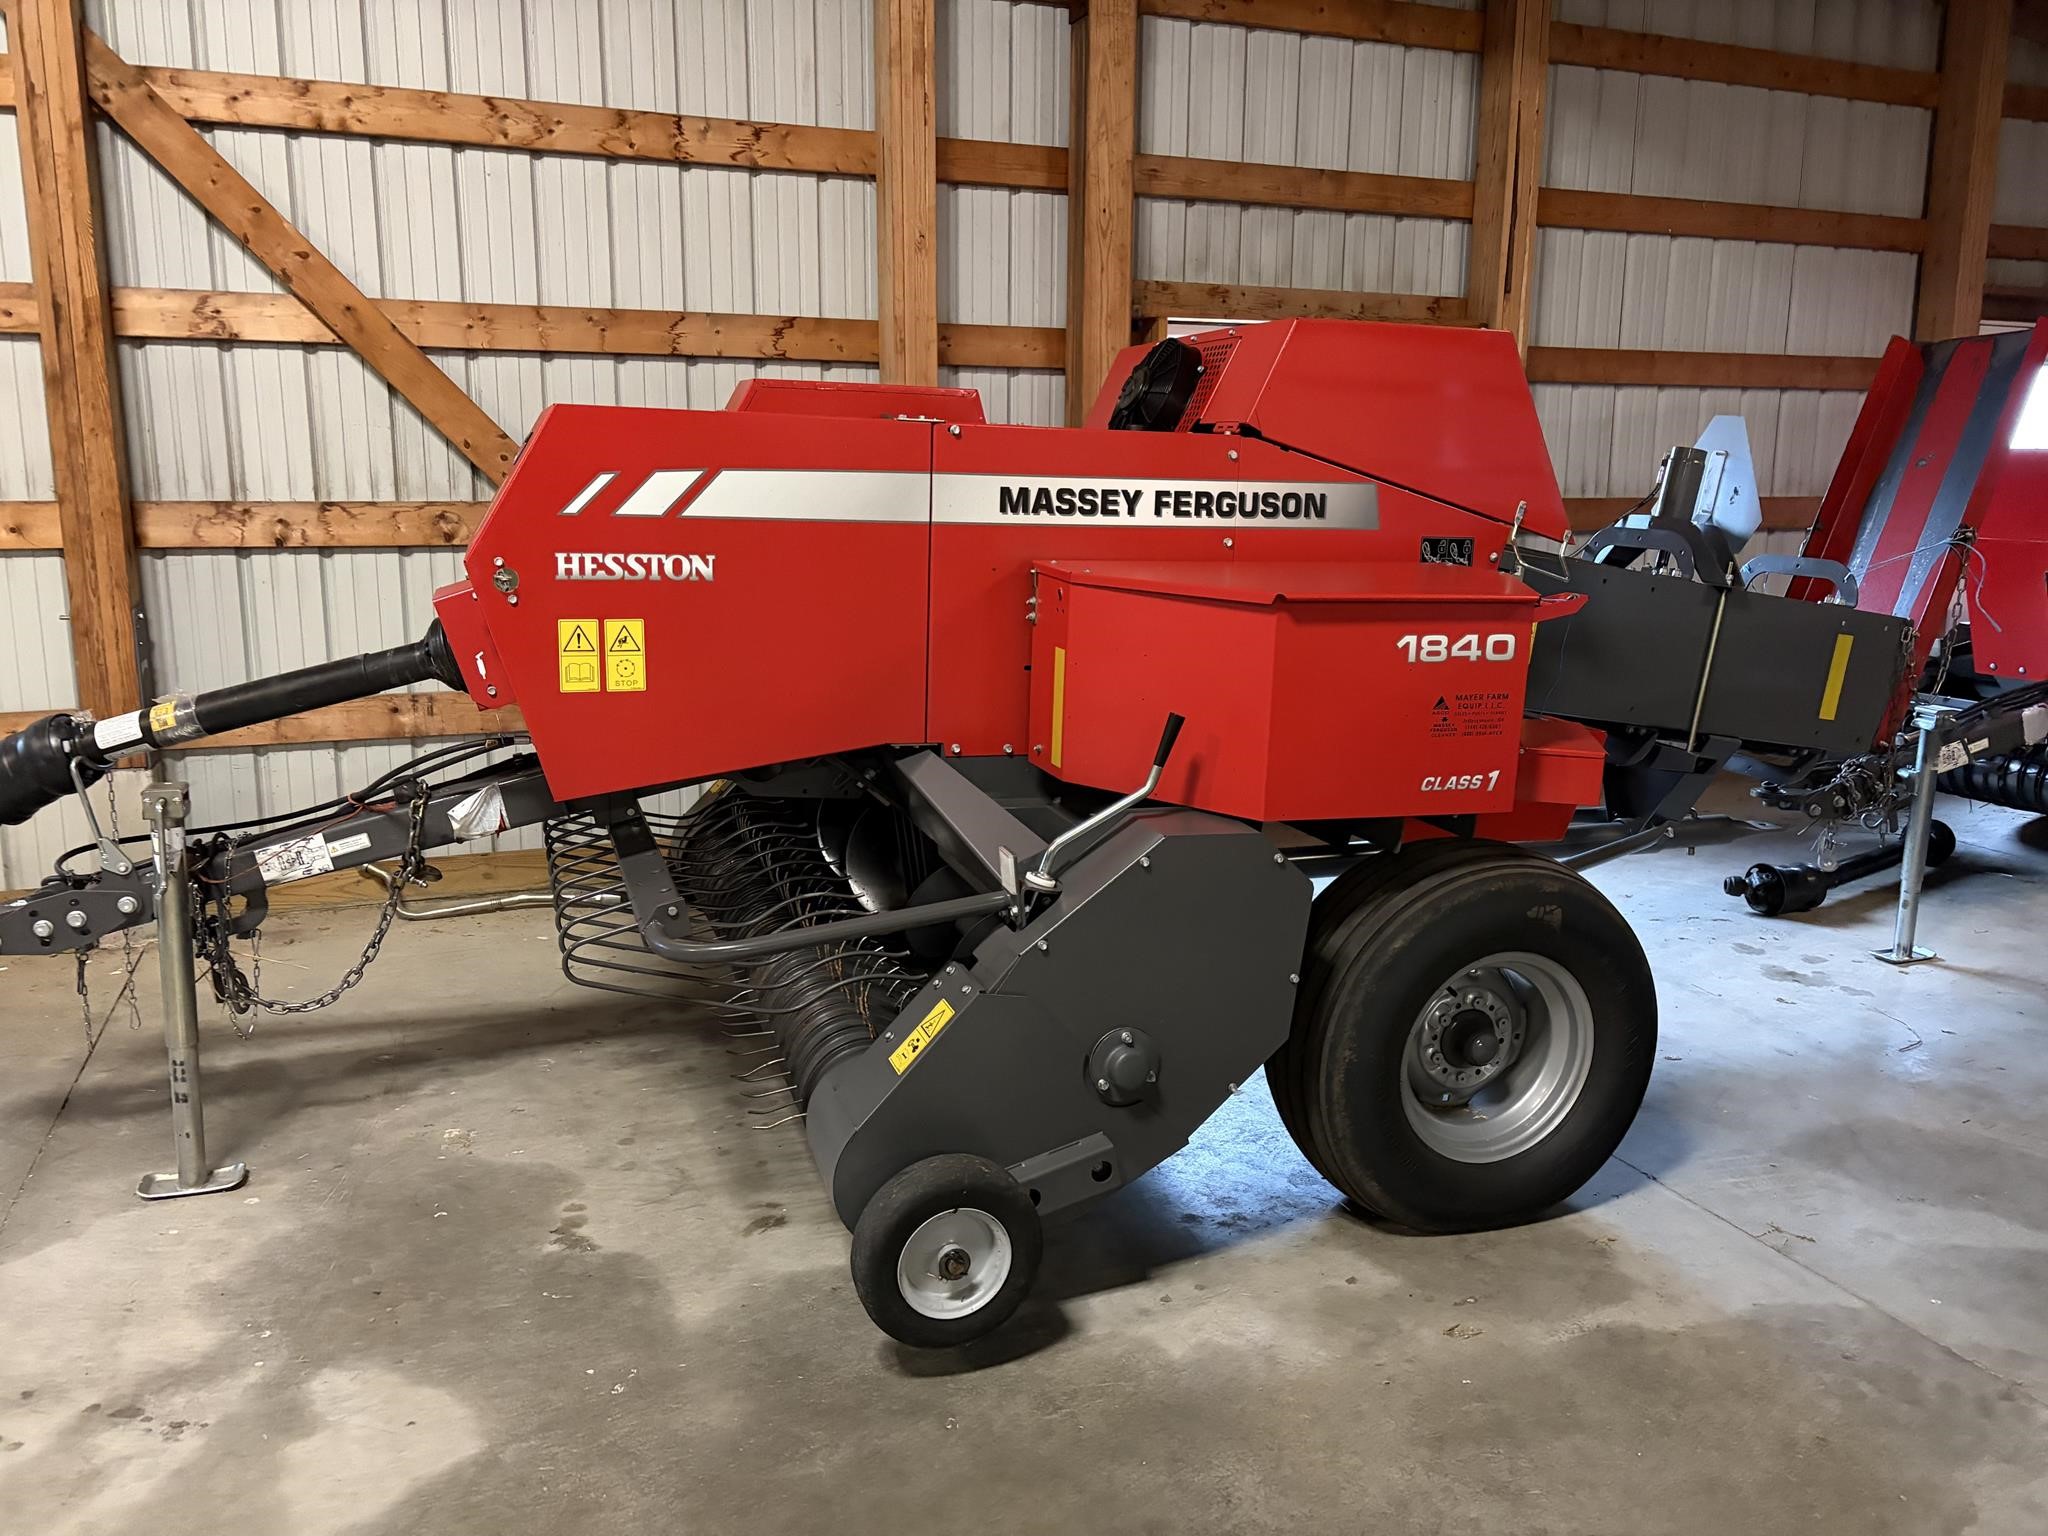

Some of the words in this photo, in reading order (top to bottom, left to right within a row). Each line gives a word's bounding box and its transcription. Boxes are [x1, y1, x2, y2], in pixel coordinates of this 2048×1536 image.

[999, 486, 1144, 517] MASSEY
[1154, 490, 1328, 520] FERGUSON
[554, 552, 716, 582] HESSTON
[1396, 633, 1516, 663] 1840
[615, 679, 639, 687] STOP
[1455, 693, 1484, 701] MAYER
[1486, 692, 1510, 700] FARM
[1420, 774, 1484, 792] CLASS
[1486, 769, 1501, 792] 1
